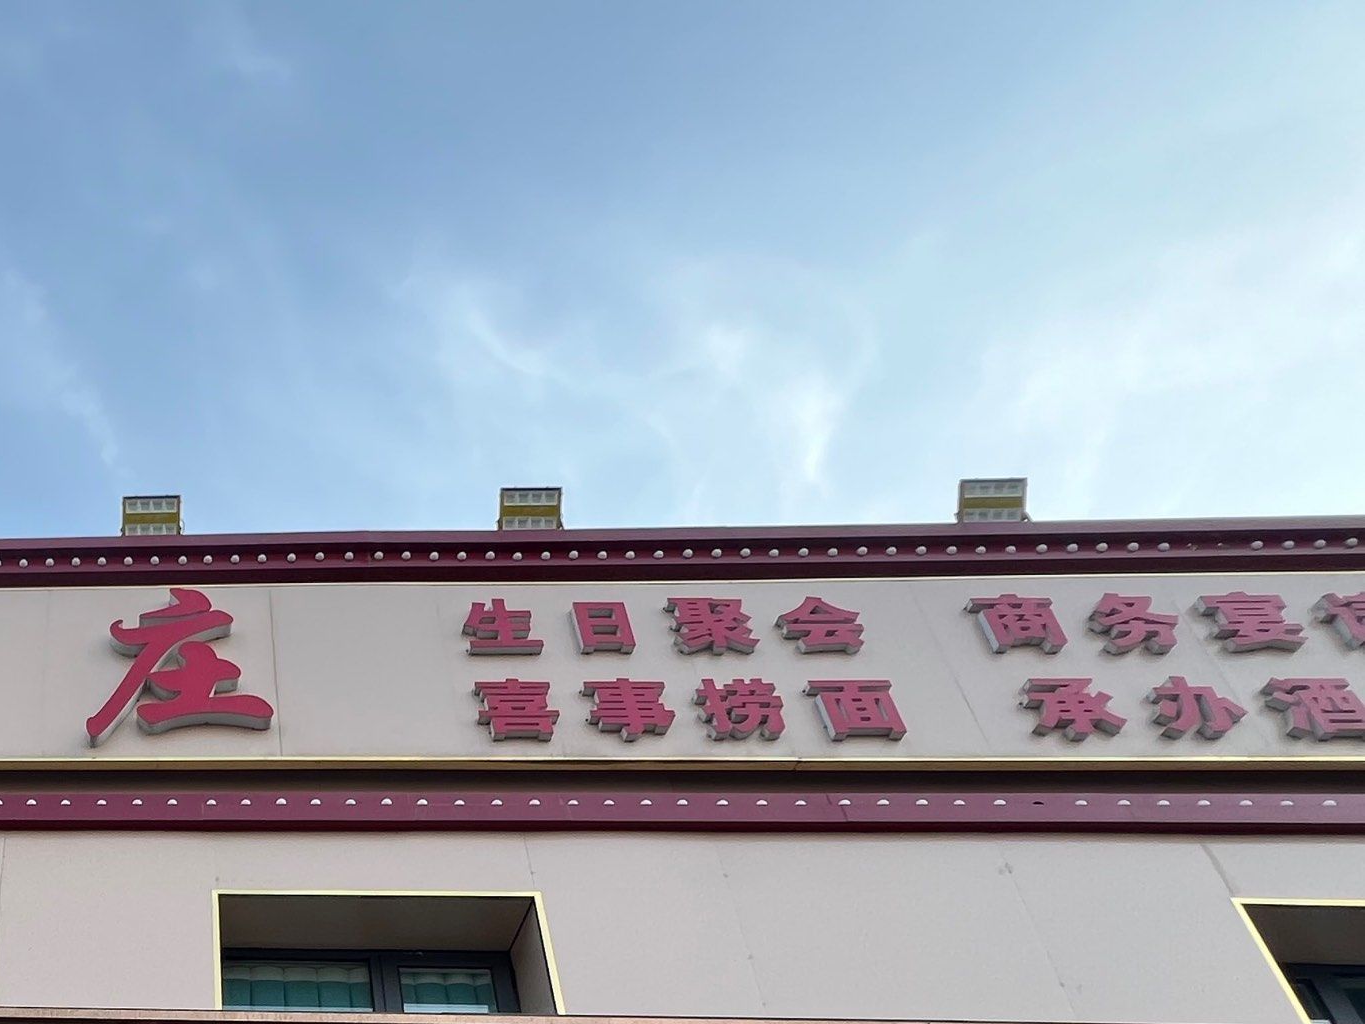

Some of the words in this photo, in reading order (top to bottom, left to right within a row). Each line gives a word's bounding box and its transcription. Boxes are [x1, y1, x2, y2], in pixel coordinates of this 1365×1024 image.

[463, 596, 865, 656] 生日聚会
[473, 678, 908, 742] 喜事捞面
[1021, 676, 1365, 742] 承办酒
